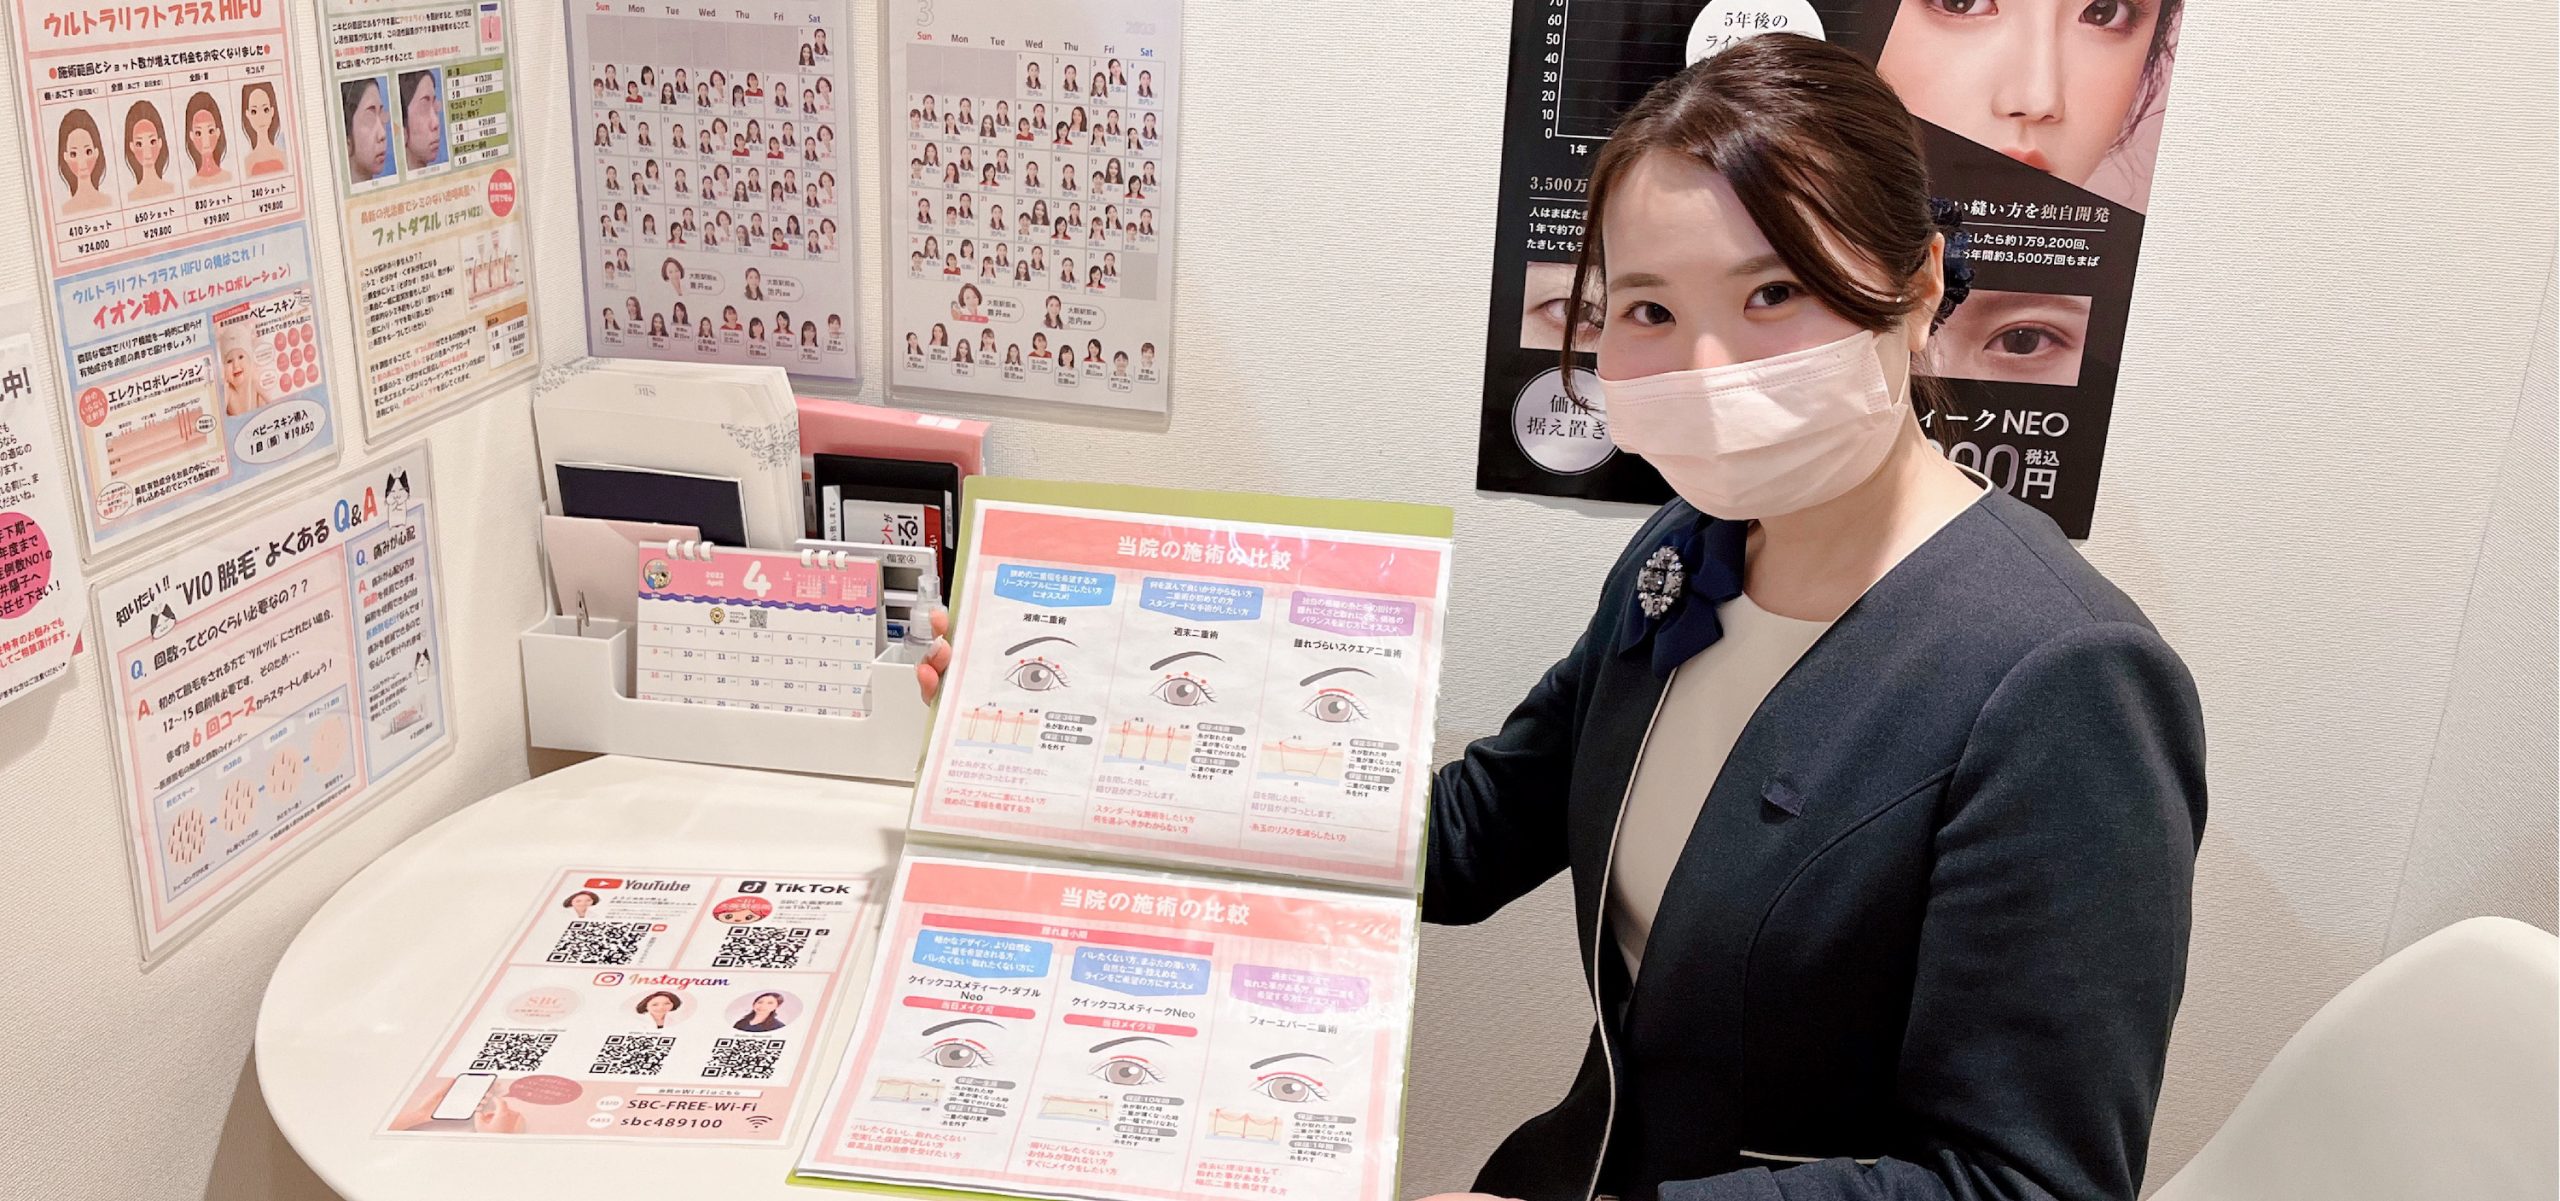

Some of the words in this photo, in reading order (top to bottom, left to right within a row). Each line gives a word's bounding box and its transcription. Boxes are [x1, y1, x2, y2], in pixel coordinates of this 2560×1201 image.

[628, 4, 645, 14] Mon
[666, 6, 680, 15] Tue
[699, 8, 716, 18] Wed
[735, 10, 750, 20] Thu
[774, 12, 784, 22] Fri
[808, 14, 821, 24] Sat
[1547, 14, 1562, 26] 60
[1724, 11, 1789, 30] 5年後の
[917, 31, 933, 42] Sun
[951, 34, 969, 44] Mon
[990, 36, 1006, 47] Tue
[1545, 33, 1561, 45] 50
[1025, 39, 1043, 50] Wed
[1064, 41, 1079, 52] Thu
[1104, 44, 1115, 54] Fri
[1140, 47, 1153, 58] Sat
[1544, 53, 1559, 64] 40
[1542, 72, 1558, 83] 30
[1541, 90, 1556, 102] 20
[1542, 109, 1554, 120] 10
[1544, 128, 1553, 139] 0
[1569, 143, 1588, 156] 1年
[1529, 176, 1589, 194] 3,500万
[1526, 416, 1606, 440] 据え置き
[2024, 448, 2060, 467] 税込
[2021, 467, 2058, 500] 円
[333, 485, 379, 534] Q&A
[742, 560, 772, 598] 4
[685, 626, 691, 634] 3
[753, 631, 759, 639] 5
[683, 650, 693, 658] 10
[750, 655, 760, 663] 12
[818, 660, 828, 668] 14
[750, 679, 760, 687] 19
[818, 684, 827, 692] 21
[750, 702, 760, 710] 26
[624, 879, 691, 892] YouTube
[1060, 885, 1251, 926] 当院の施術の比較
[628, 972, 731, 990] Instagram
[960, 990, 984, 1002] Neo
[627, 1099, 758, 1113] SBC-FREE-Wi-Fi
[620, 1115, 724, 1129] sbc489100
